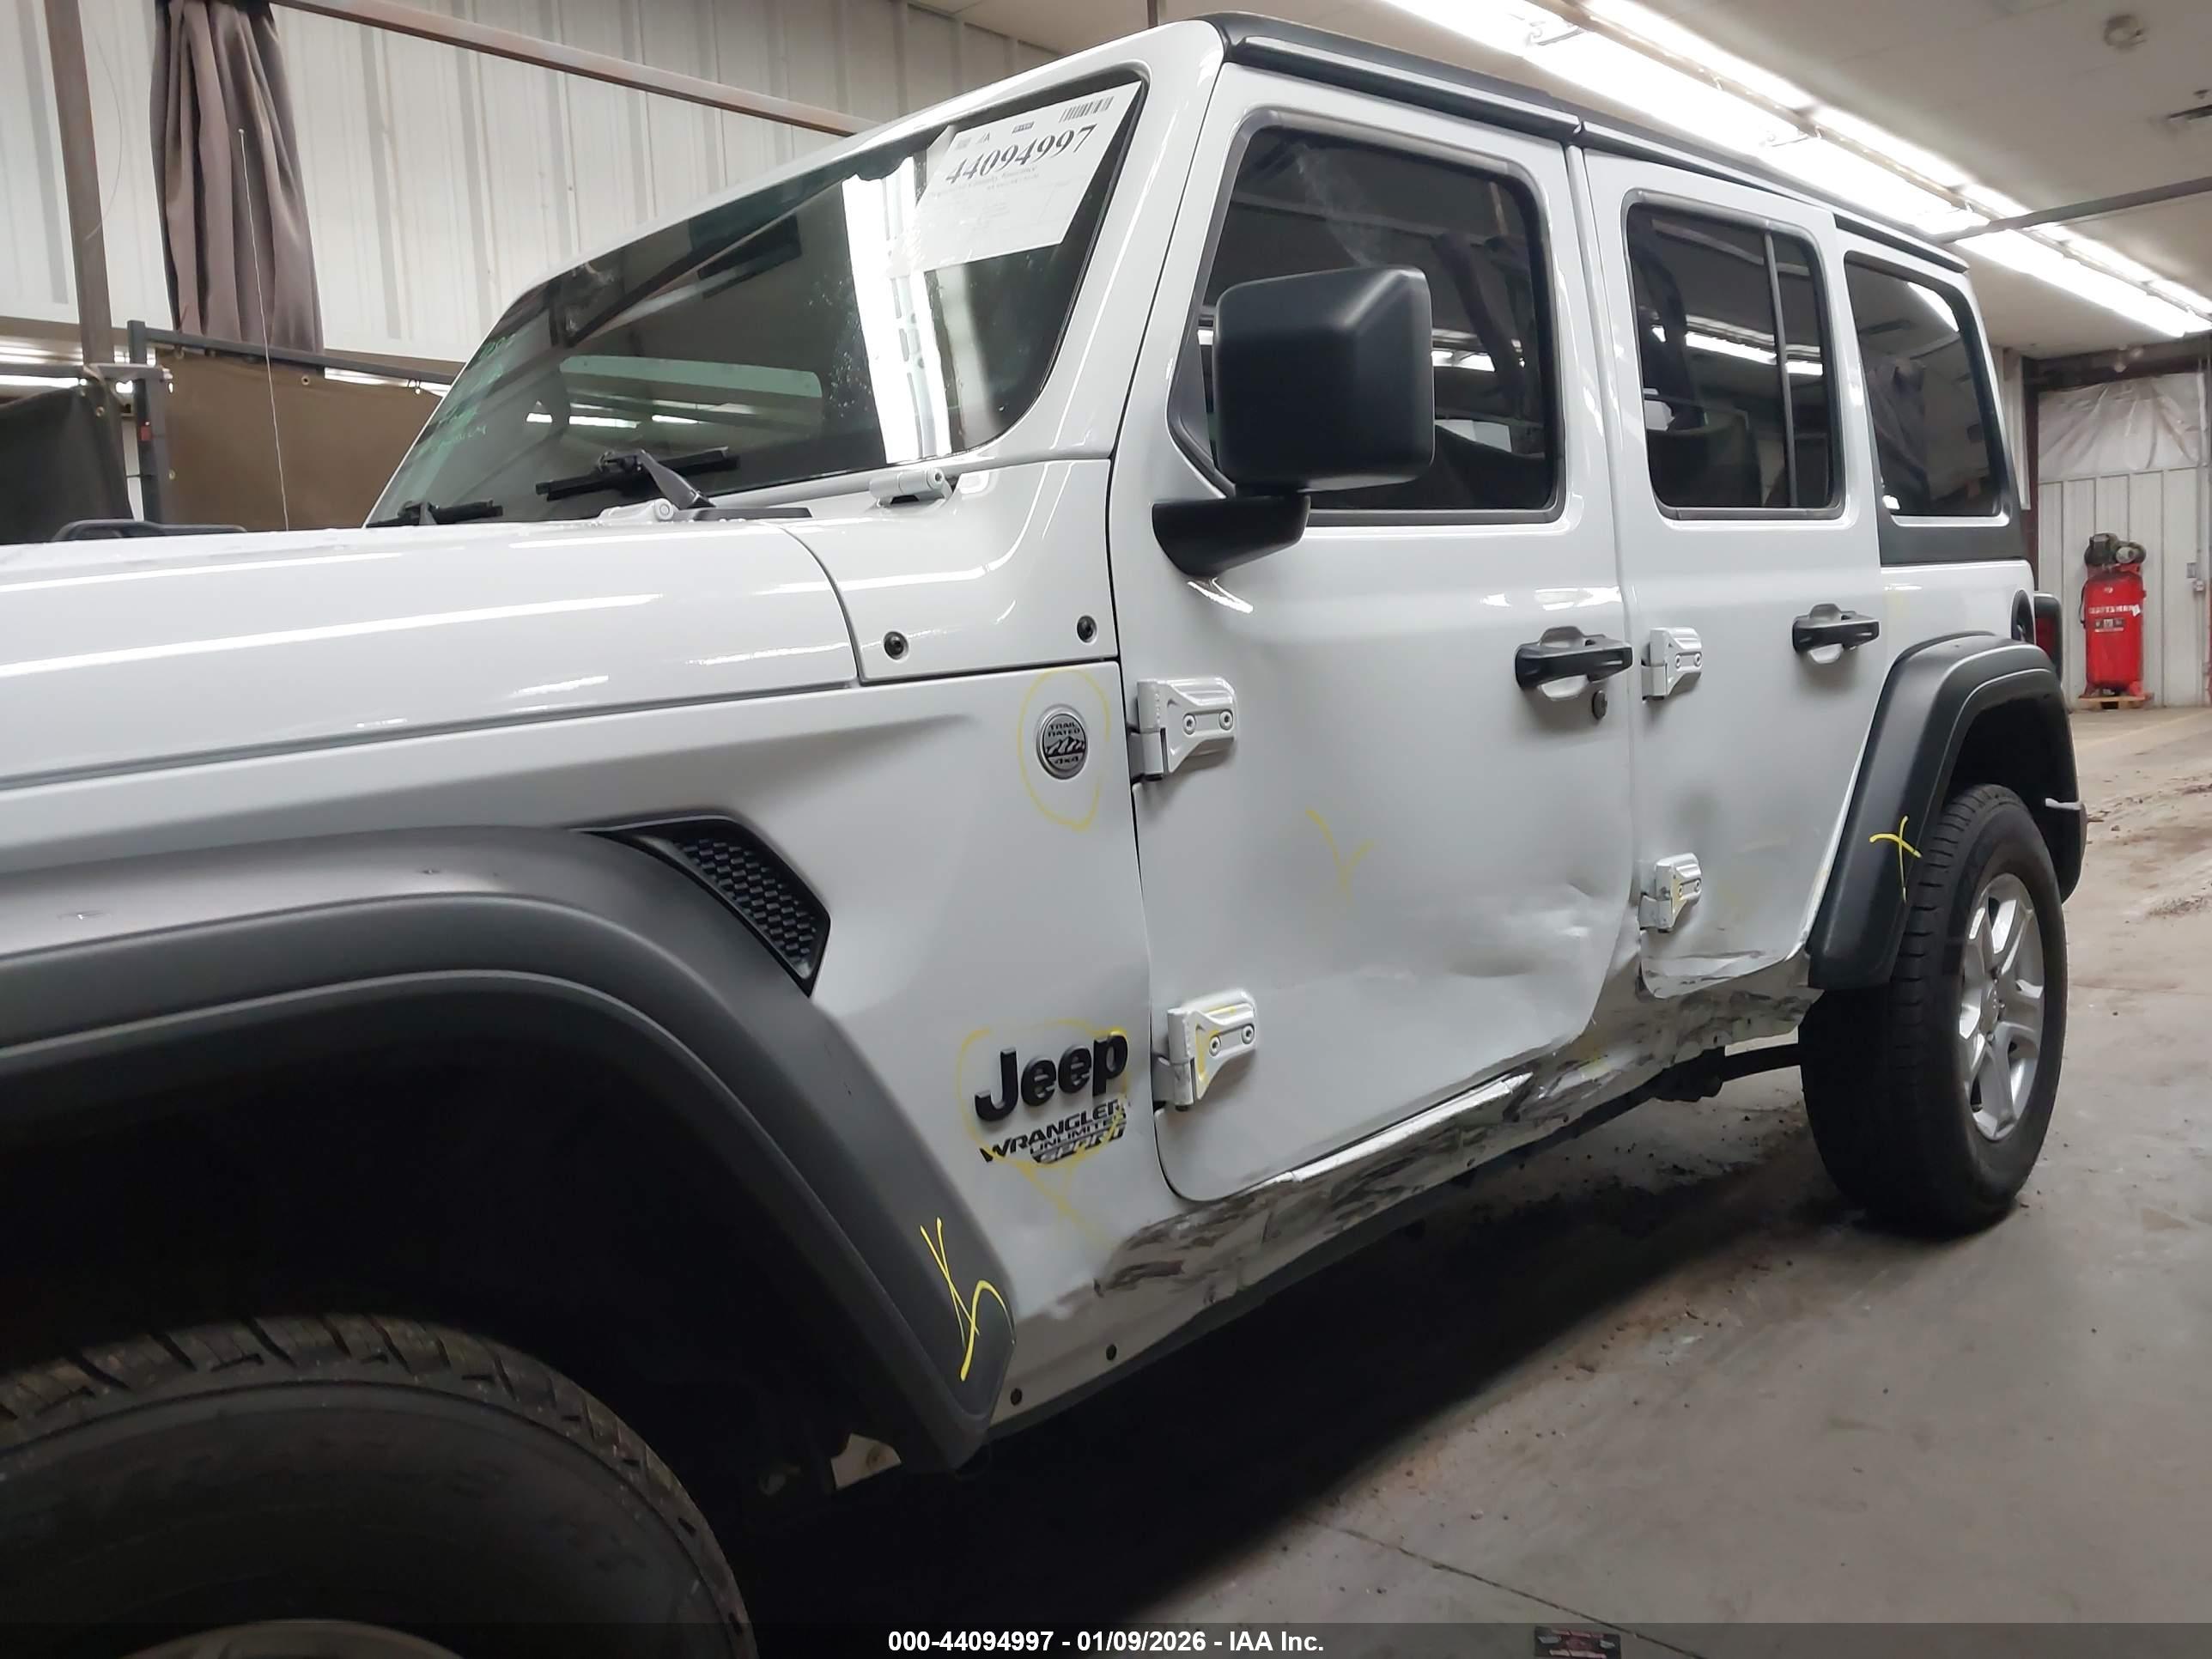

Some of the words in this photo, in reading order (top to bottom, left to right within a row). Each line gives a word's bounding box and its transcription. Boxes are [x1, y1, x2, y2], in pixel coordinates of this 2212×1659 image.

[945, 123, 1098, 184] 44094997
[974, 1030, 1128, 1121] Jeep
[979, 1097, 1127, 1163] WRANGLER
